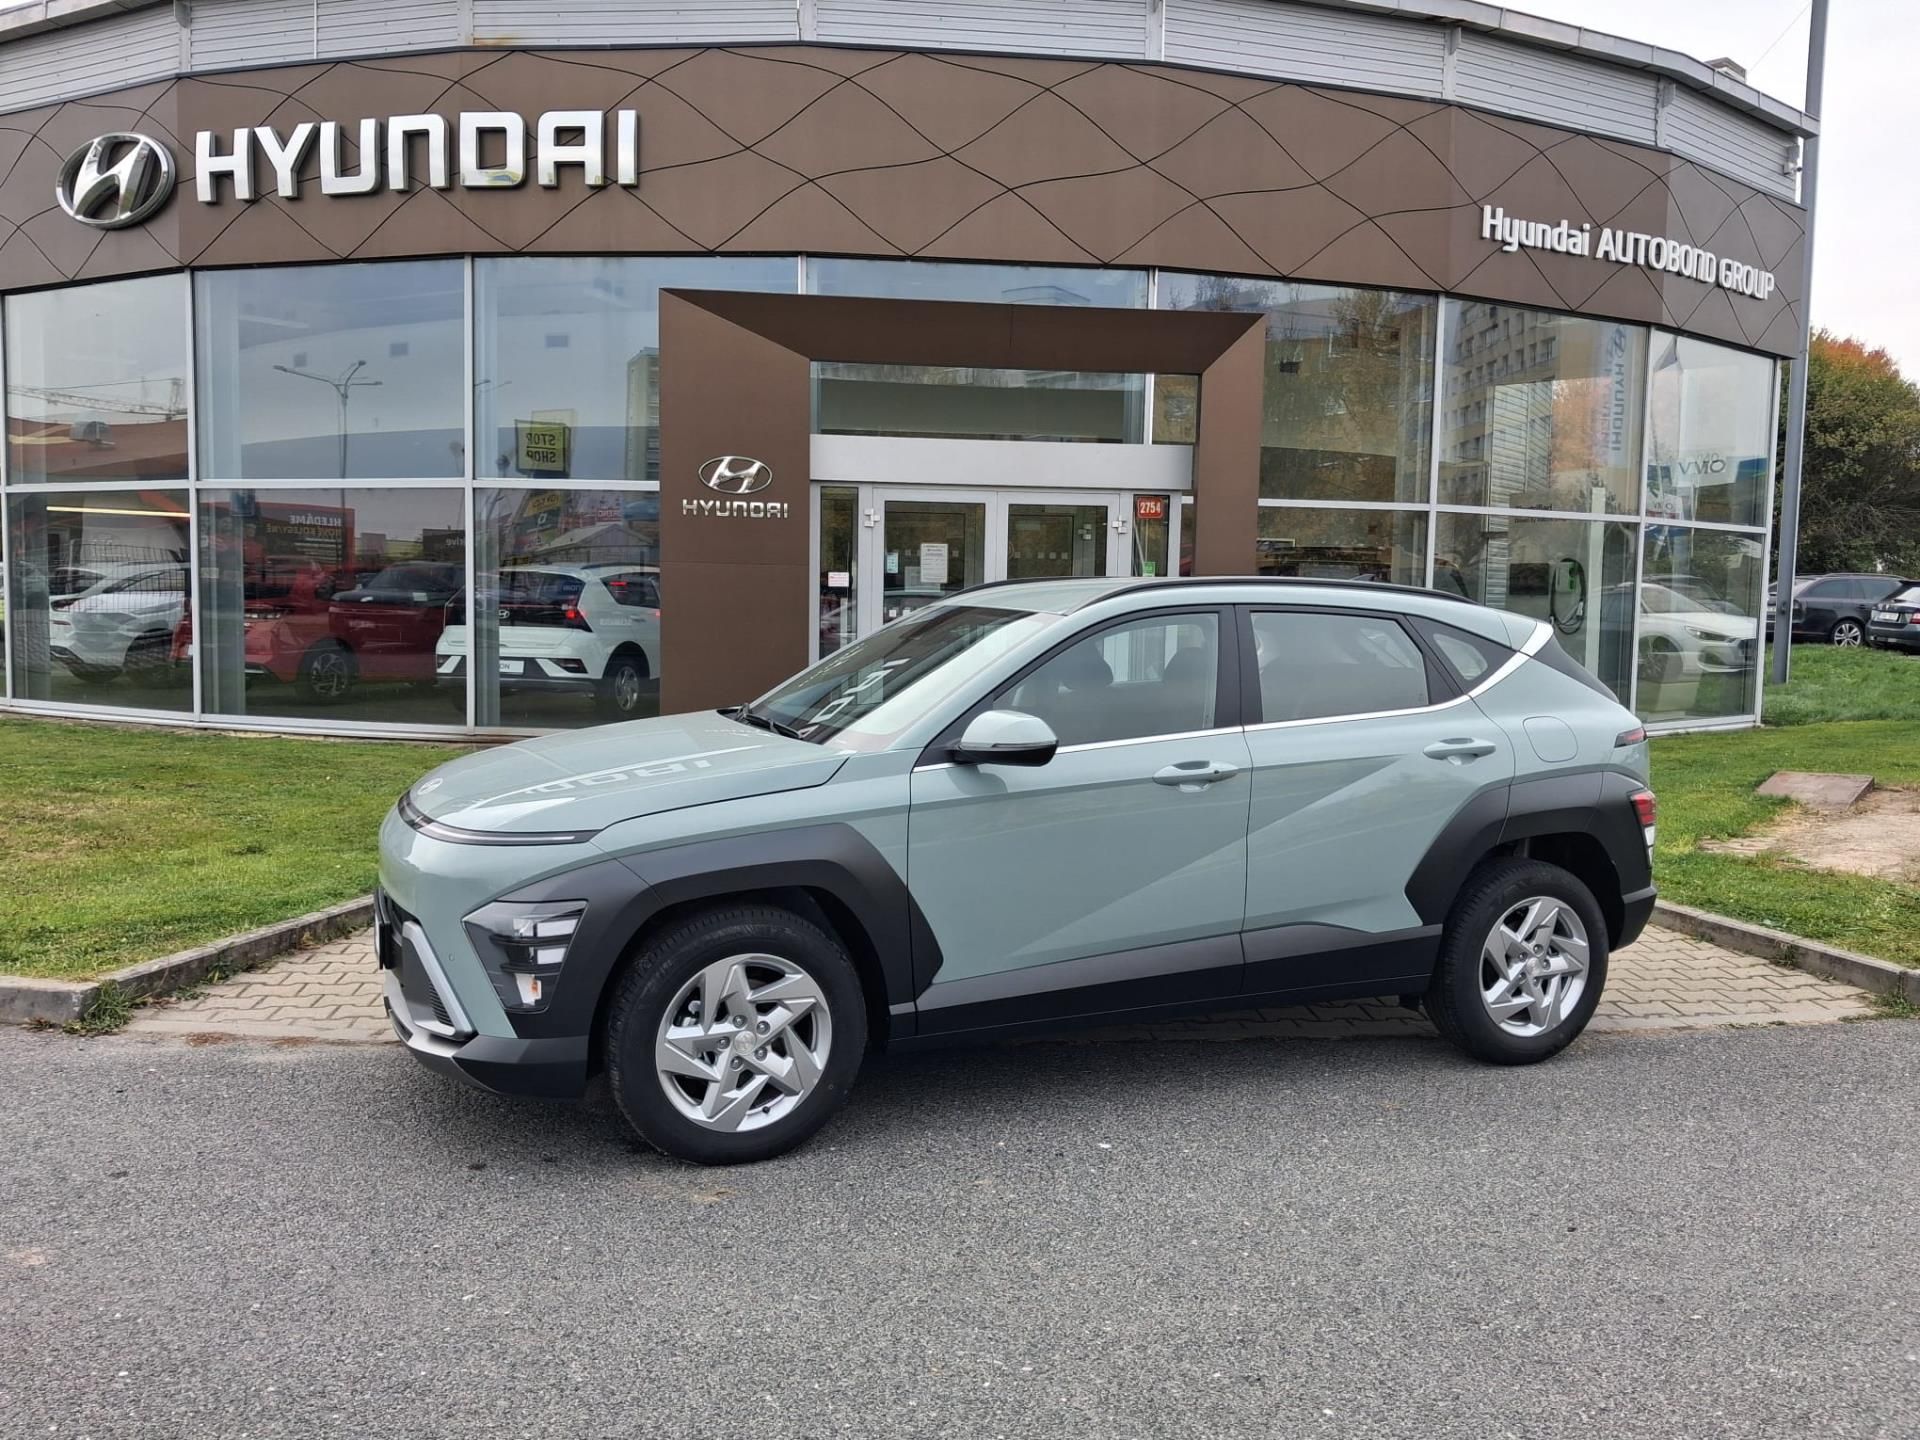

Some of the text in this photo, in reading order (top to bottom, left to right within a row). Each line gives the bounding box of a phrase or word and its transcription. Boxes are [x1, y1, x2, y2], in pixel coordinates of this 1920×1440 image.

[195, 109, 638, 203] HYUNDAI
[1482, 205, 1775, 300] Hyundai AUTOBOND GROUP
[682, 499, 788, 518] HYUNDAI
[1140, 502, 1161, 513] 2754
